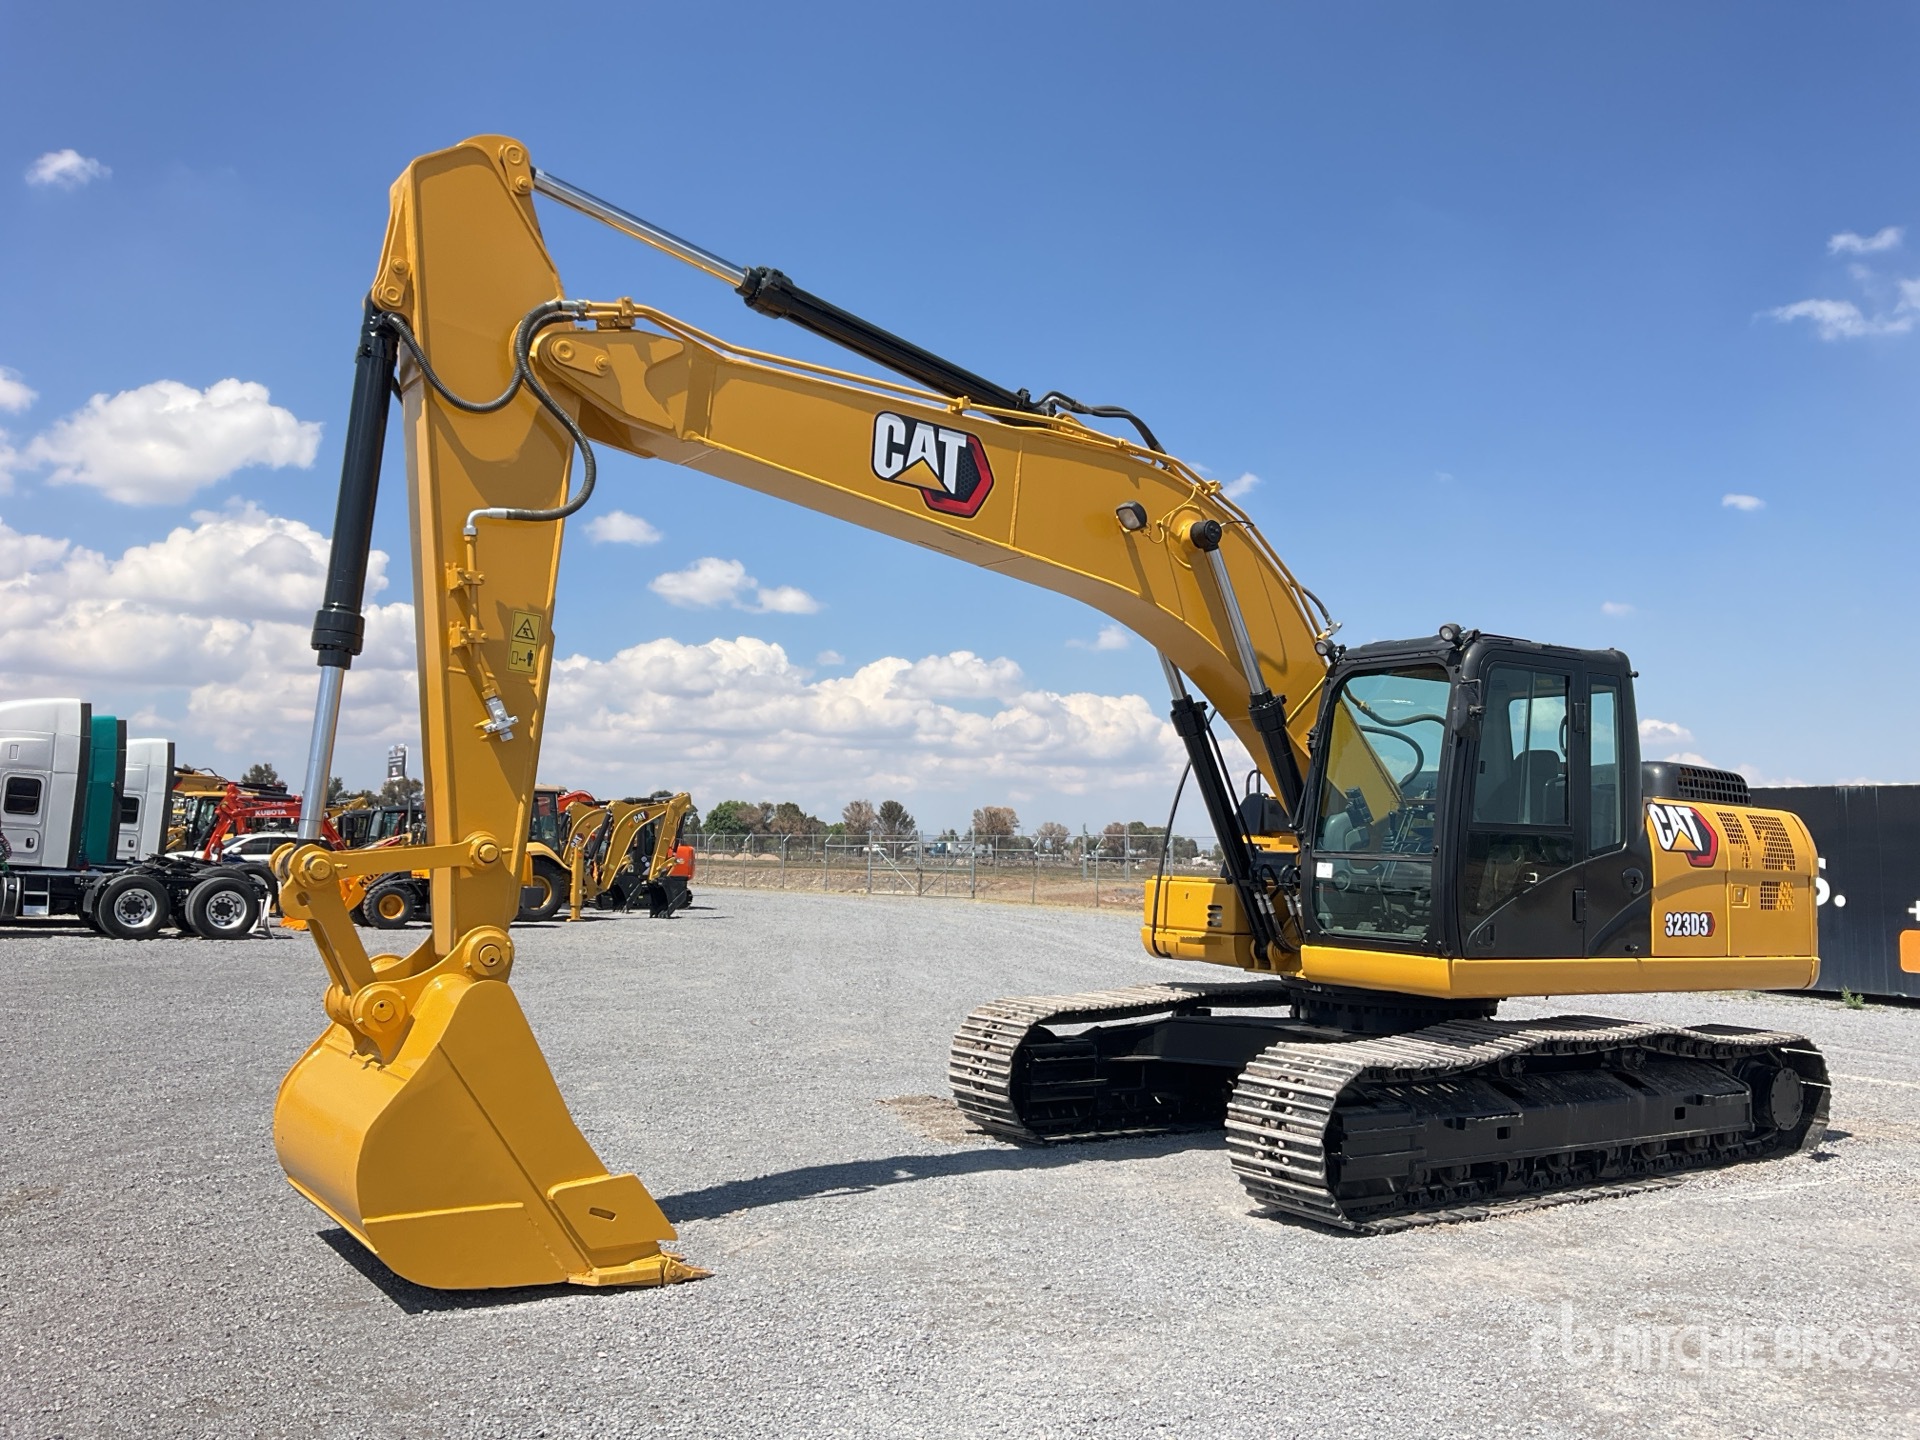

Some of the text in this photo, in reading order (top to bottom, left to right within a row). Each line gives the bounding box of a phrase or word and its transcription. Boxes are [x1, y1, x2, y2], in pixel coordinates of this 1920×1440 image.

[873, 413, 967, 495] CAT
[255, 809, 287, 817] KUBOTA
[633, 811, 646, 824] CAT
[1647, 803, 1703, 852] CAT
[1665, 912, 1709, 937] 323D3
